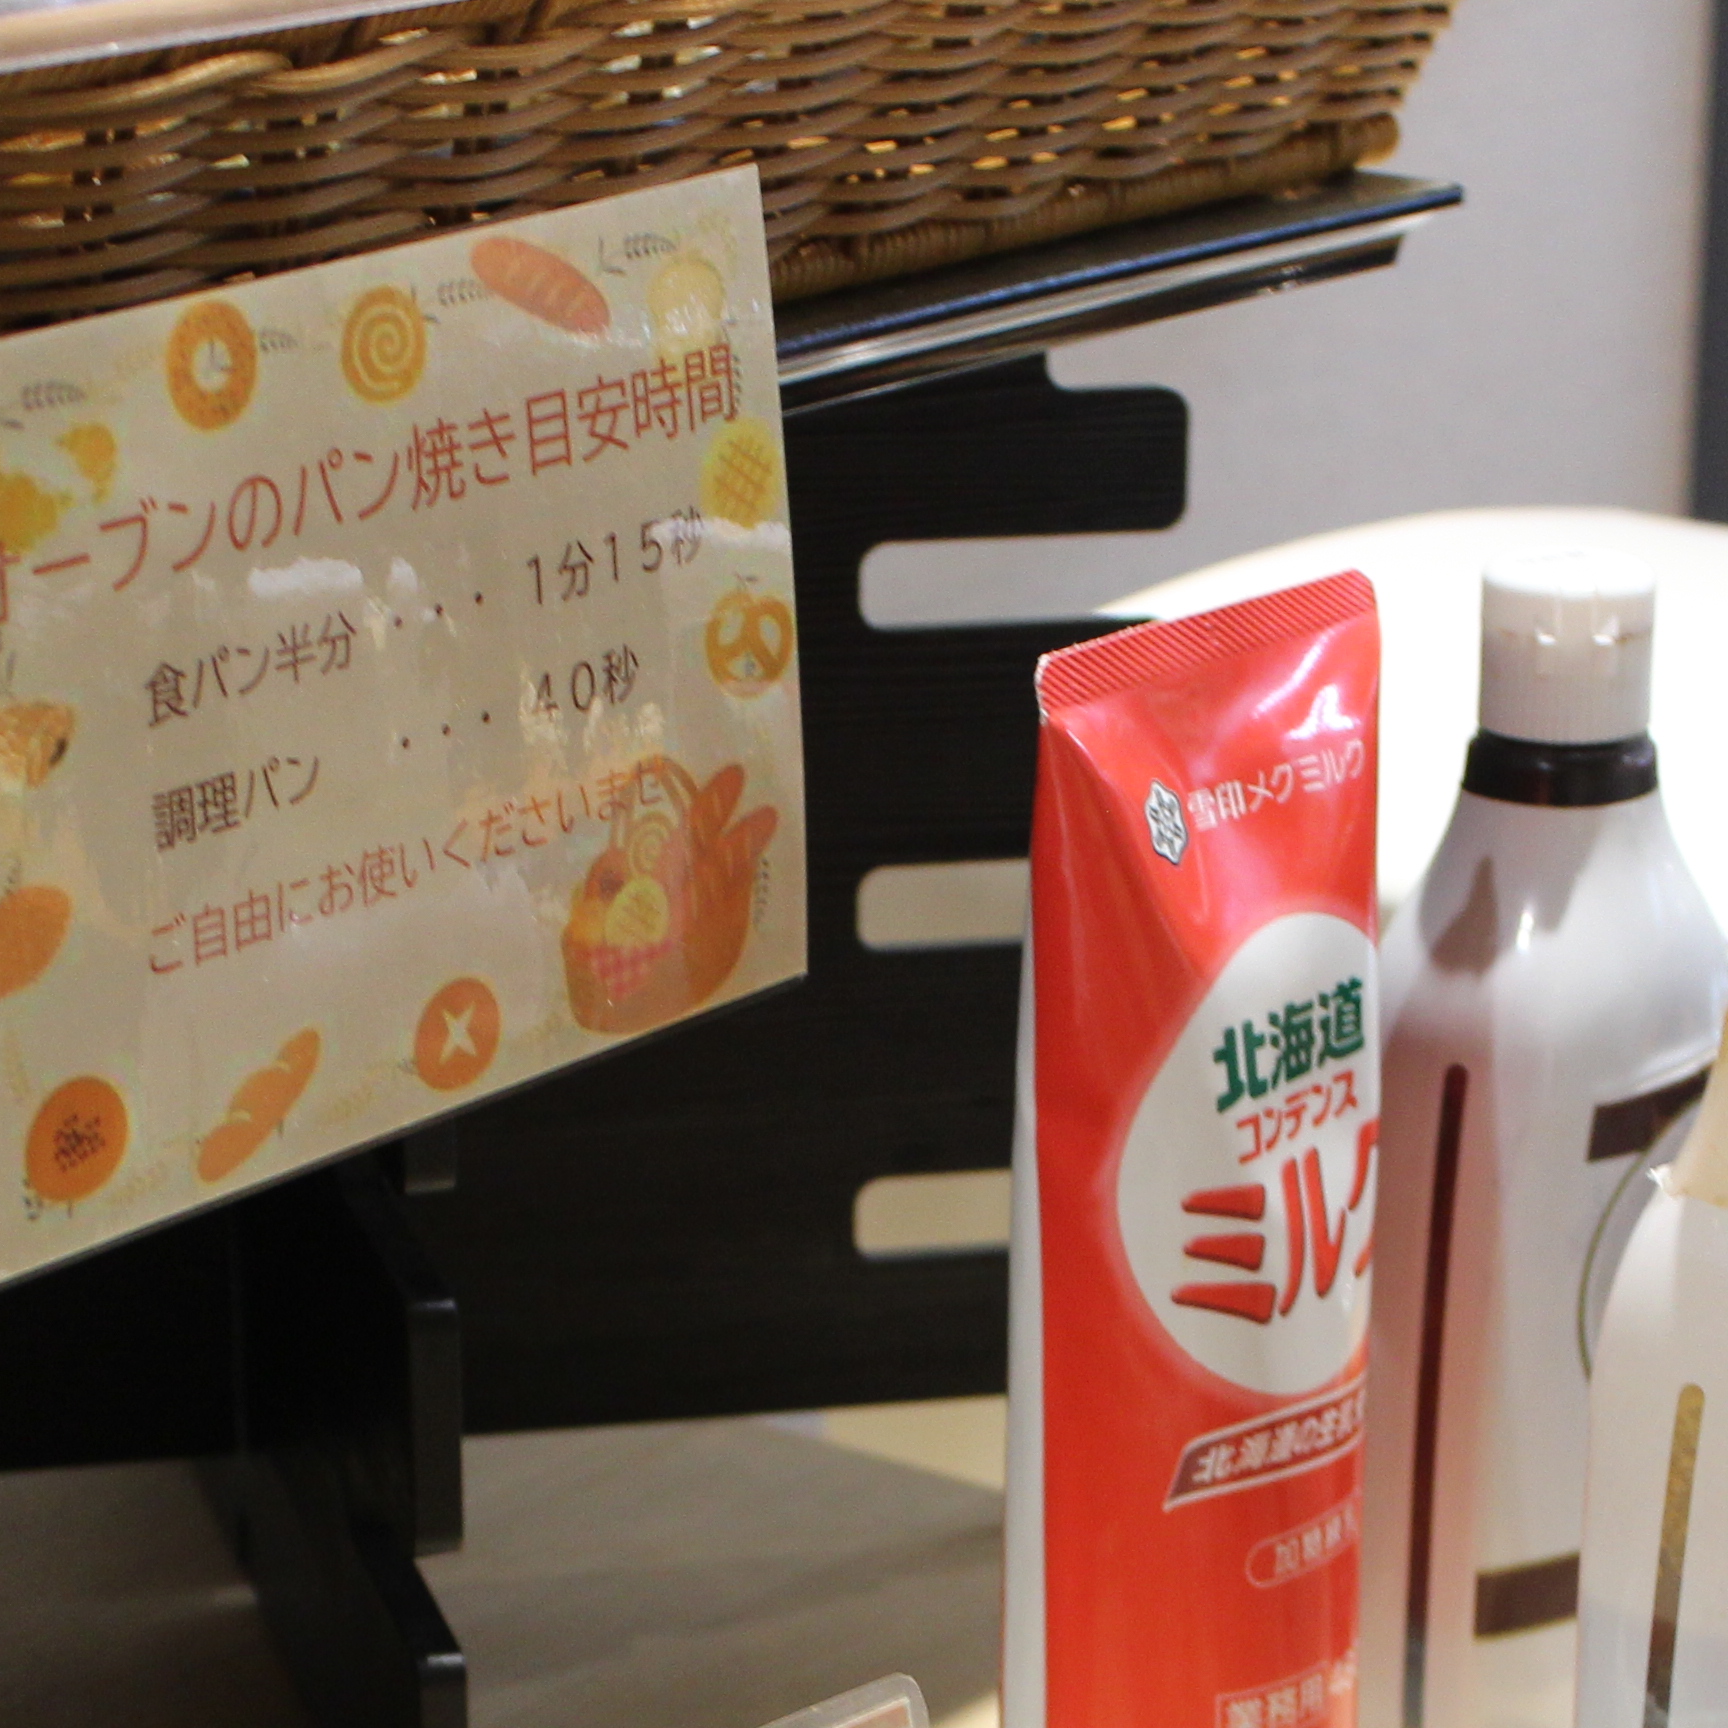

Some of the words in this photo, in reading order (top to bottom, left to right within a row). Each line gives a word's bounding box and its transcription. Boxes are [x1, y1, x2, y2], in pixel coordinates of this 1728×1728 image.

[145, 612, 359, 730] 食パン半分
[151, 754, 321, 853] 調理パン
[148, 761, 666, 977] ご自由にお使いくださいませ
[1213, 976, 1366, 1113] 北海道
[1236, 1068, 1359, 1166] コンデンス
